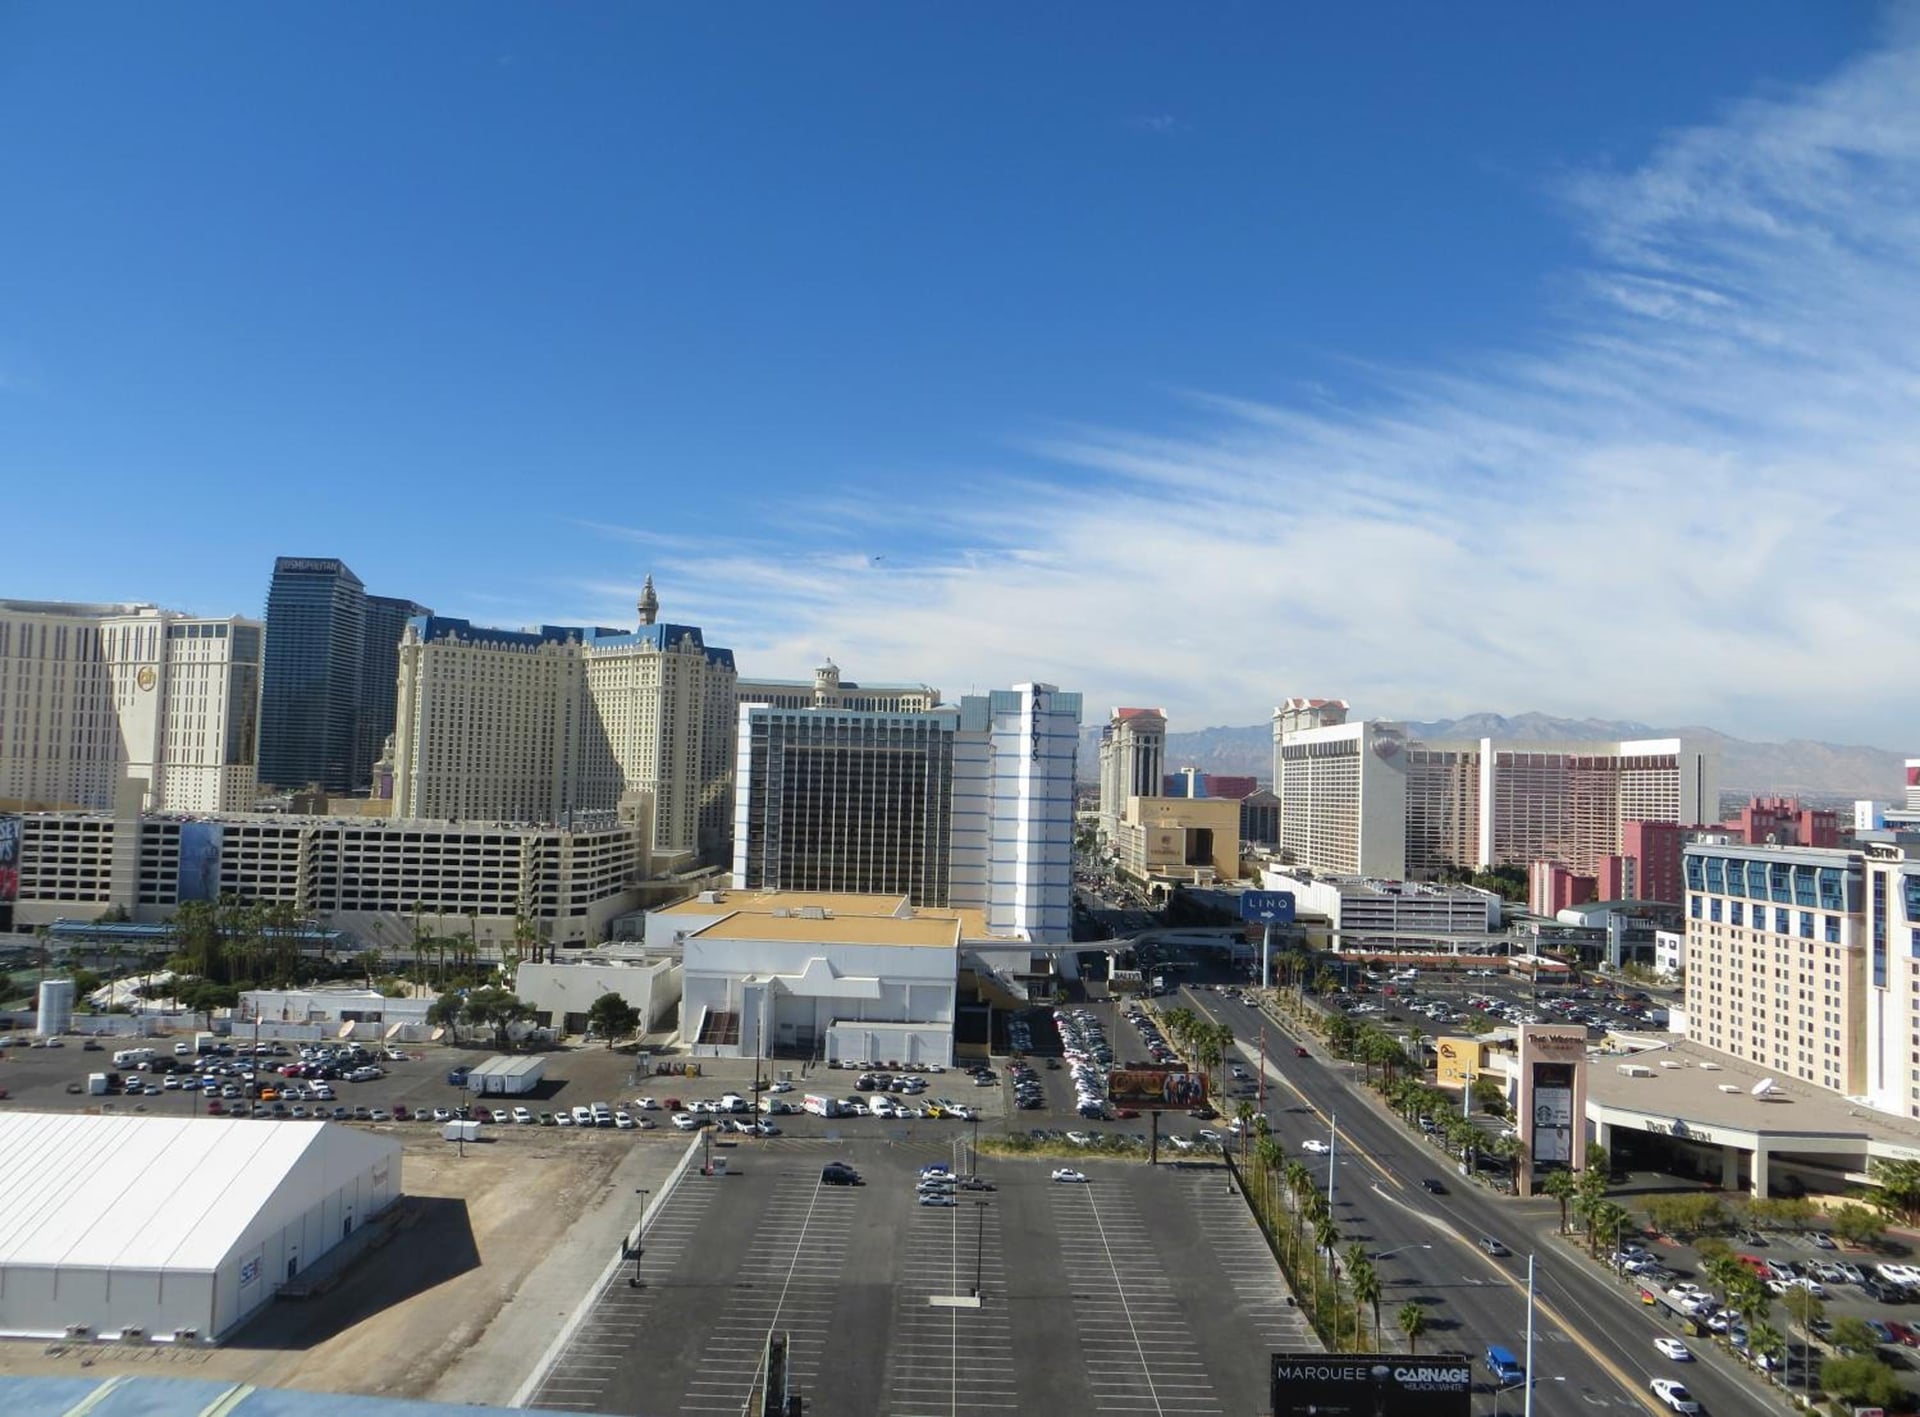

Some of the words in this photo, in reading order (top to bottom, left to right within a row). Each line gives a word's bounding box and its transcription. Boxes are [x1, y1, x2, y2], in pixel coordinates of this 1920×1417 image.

[1668, 1123, 1712, 1143] WSTIN
[1278, 1366, 1367, 1381] MARQUEE
[1394, 1367, 1469, 1383] CARNAGE
